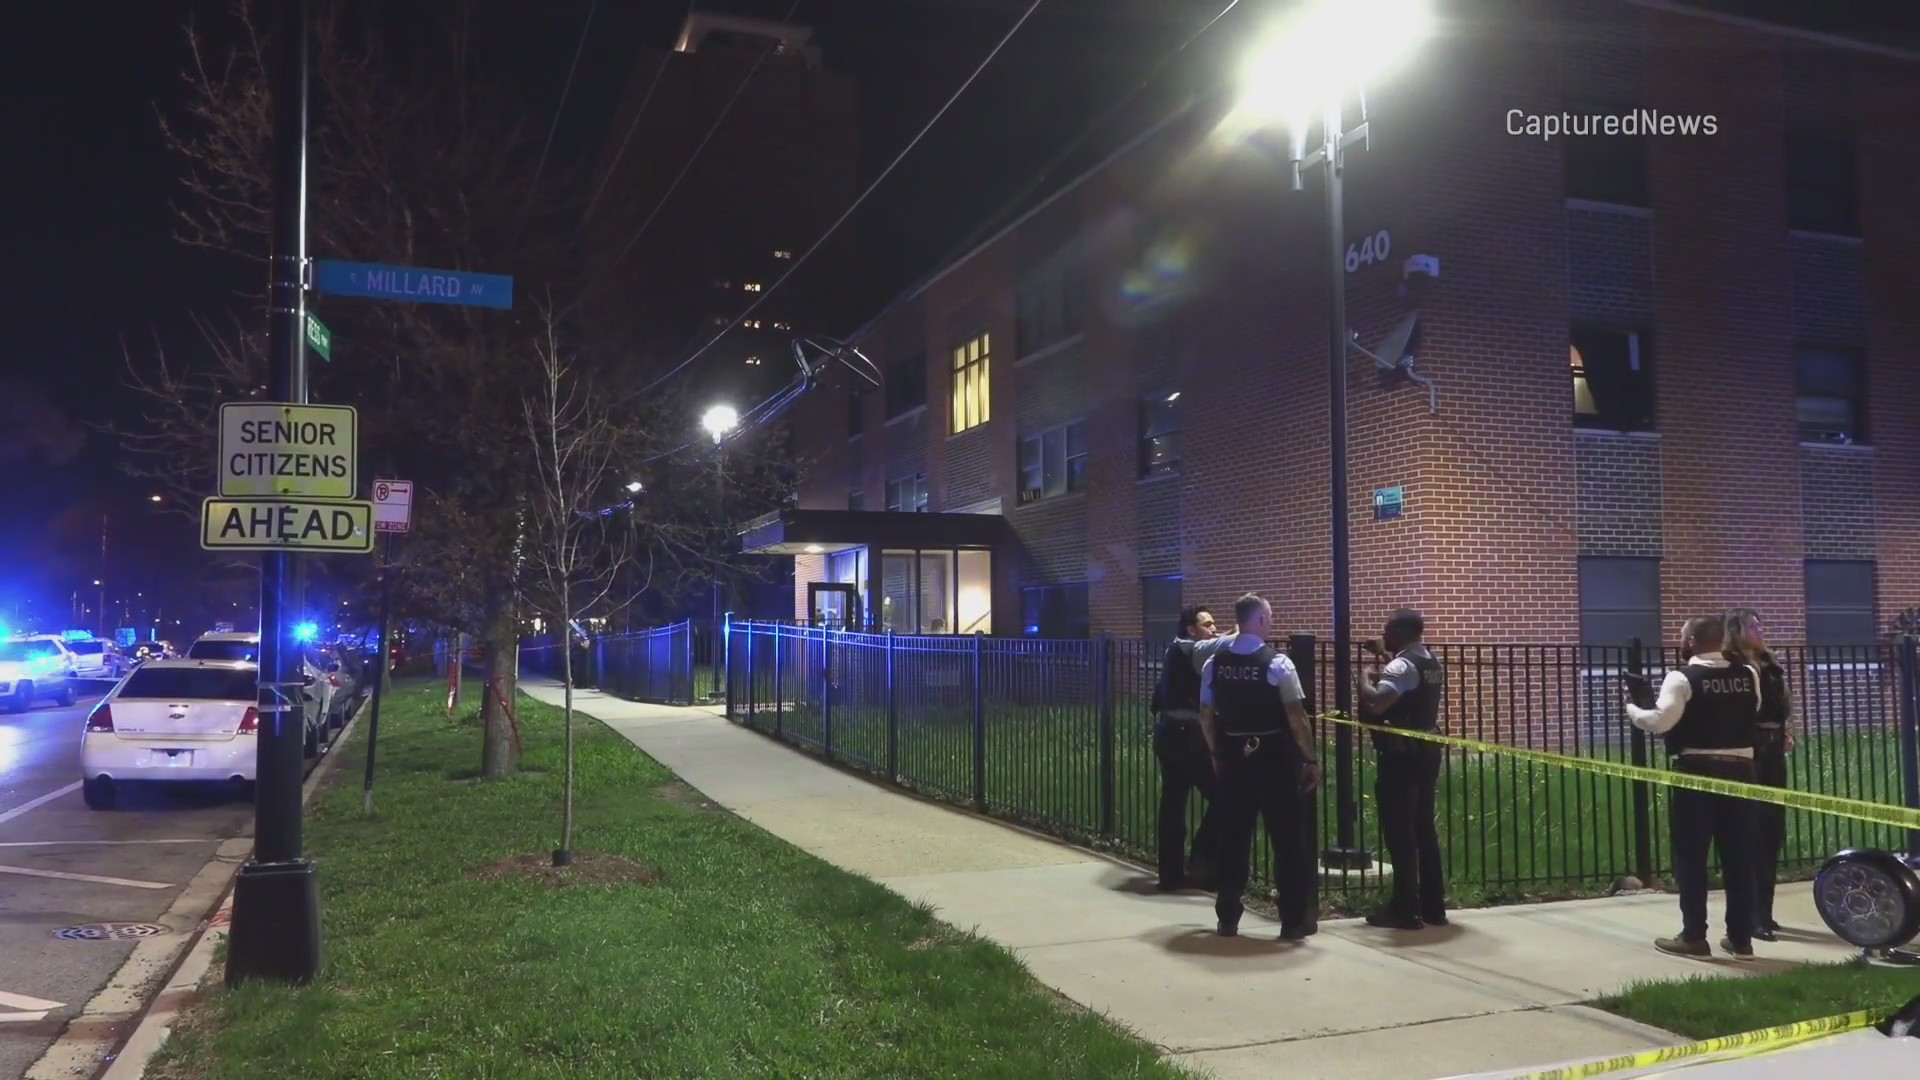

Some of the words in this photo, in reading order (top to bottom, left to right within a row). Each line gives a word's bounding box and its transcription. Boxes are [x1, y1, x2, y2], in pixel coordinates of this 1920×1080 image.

[1345, 230, 1390, 272] 640
[367, 270, 460, 297] MILLARD
[471, 283, 484, 295] AV
[240, 421, 336, 446] SENIOR
[230, 453, 347, 478] CITIZENS
[220, 507, 354, 541] AHEAD
[1217, 665, 1260, 681] POLICE
[1702, 677, 1752, 694] POLICE
